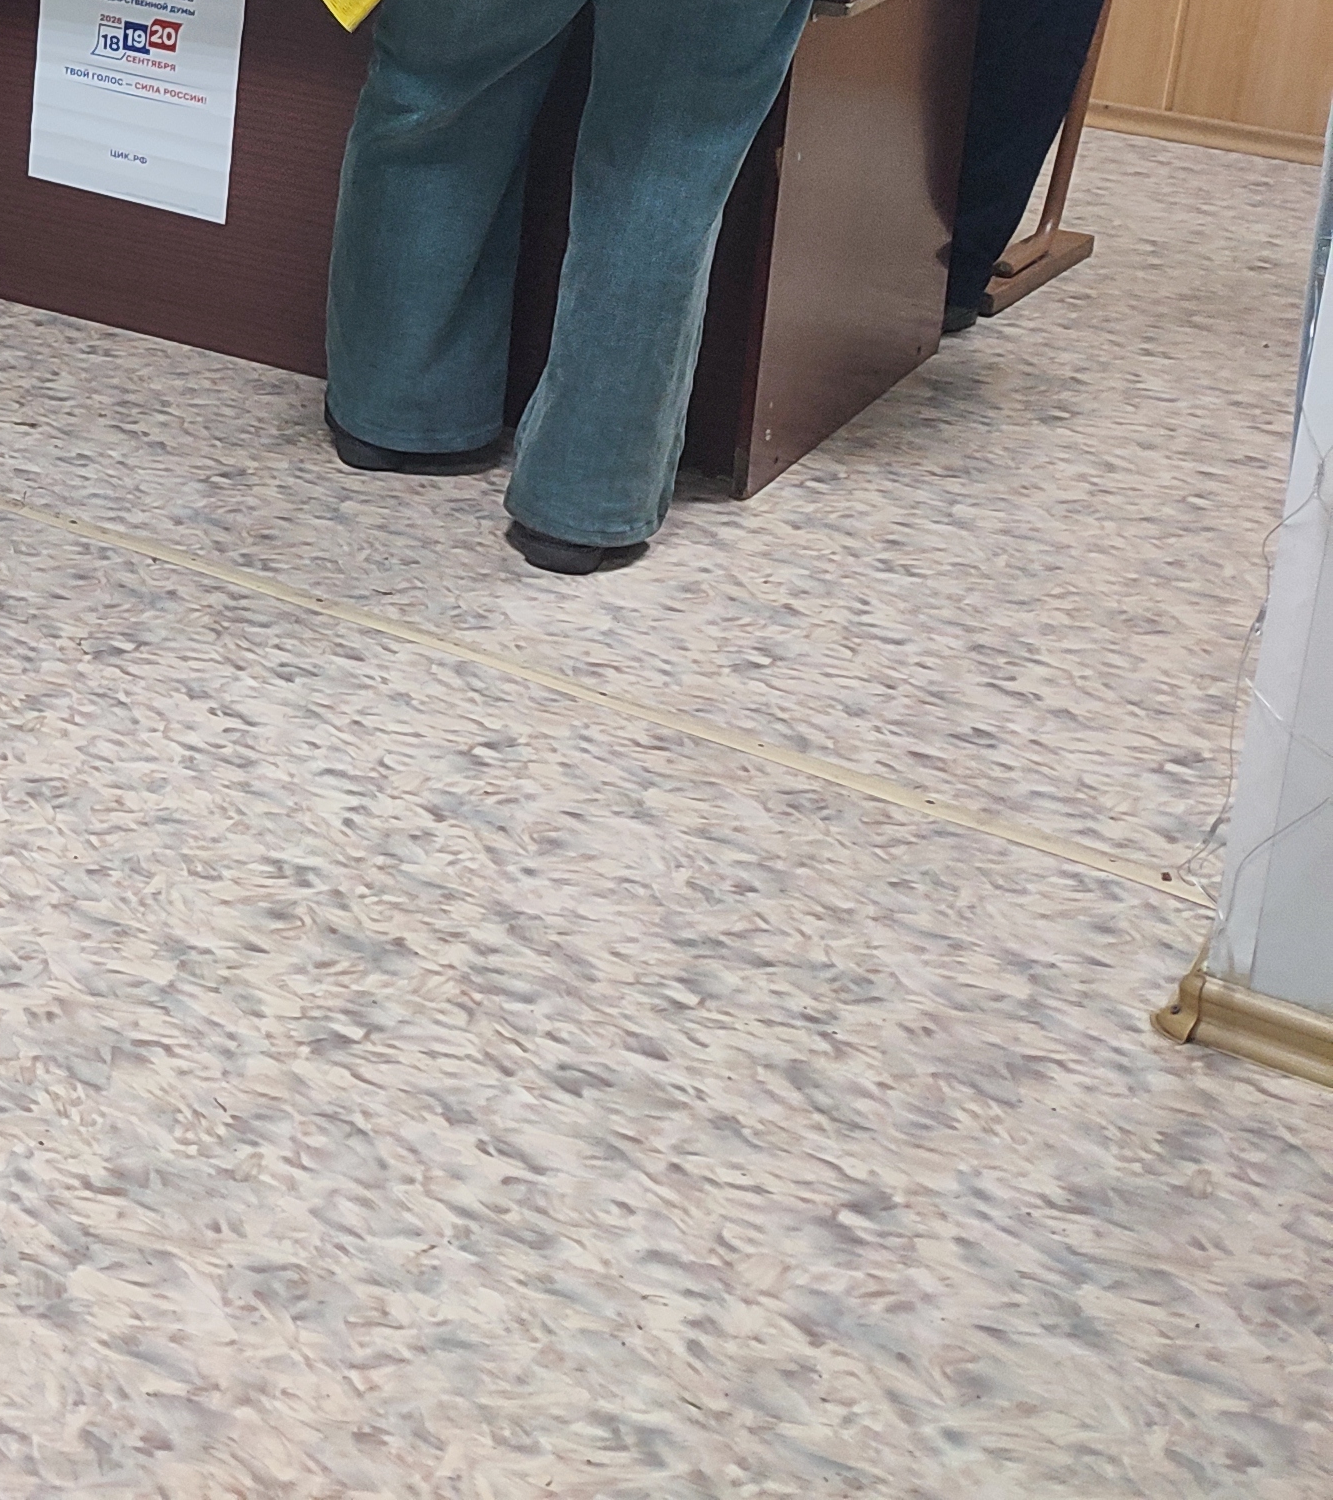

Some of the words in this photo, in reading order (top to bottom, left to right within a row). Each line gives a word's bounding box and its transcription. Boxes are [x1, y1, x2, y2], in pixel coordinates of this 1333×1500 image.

[169, 6, 196, 17] ДУМЫ
[101, 33, 120, 51] 18
[126, 28, 146, 48] 19
[151, 26, 176, 46] 20
[126, 54, 176, 72] СЕНТЯБРЯ
[64, 65, 89, 79] ТВОЙ
[92, 72, 123, 87] ГОЛОС
[134, 81, 161, 95] СИЛА
[163, 87, 208, 105] РОССИИ!
[110, 149, 148, 165] ЦИК.РФ
